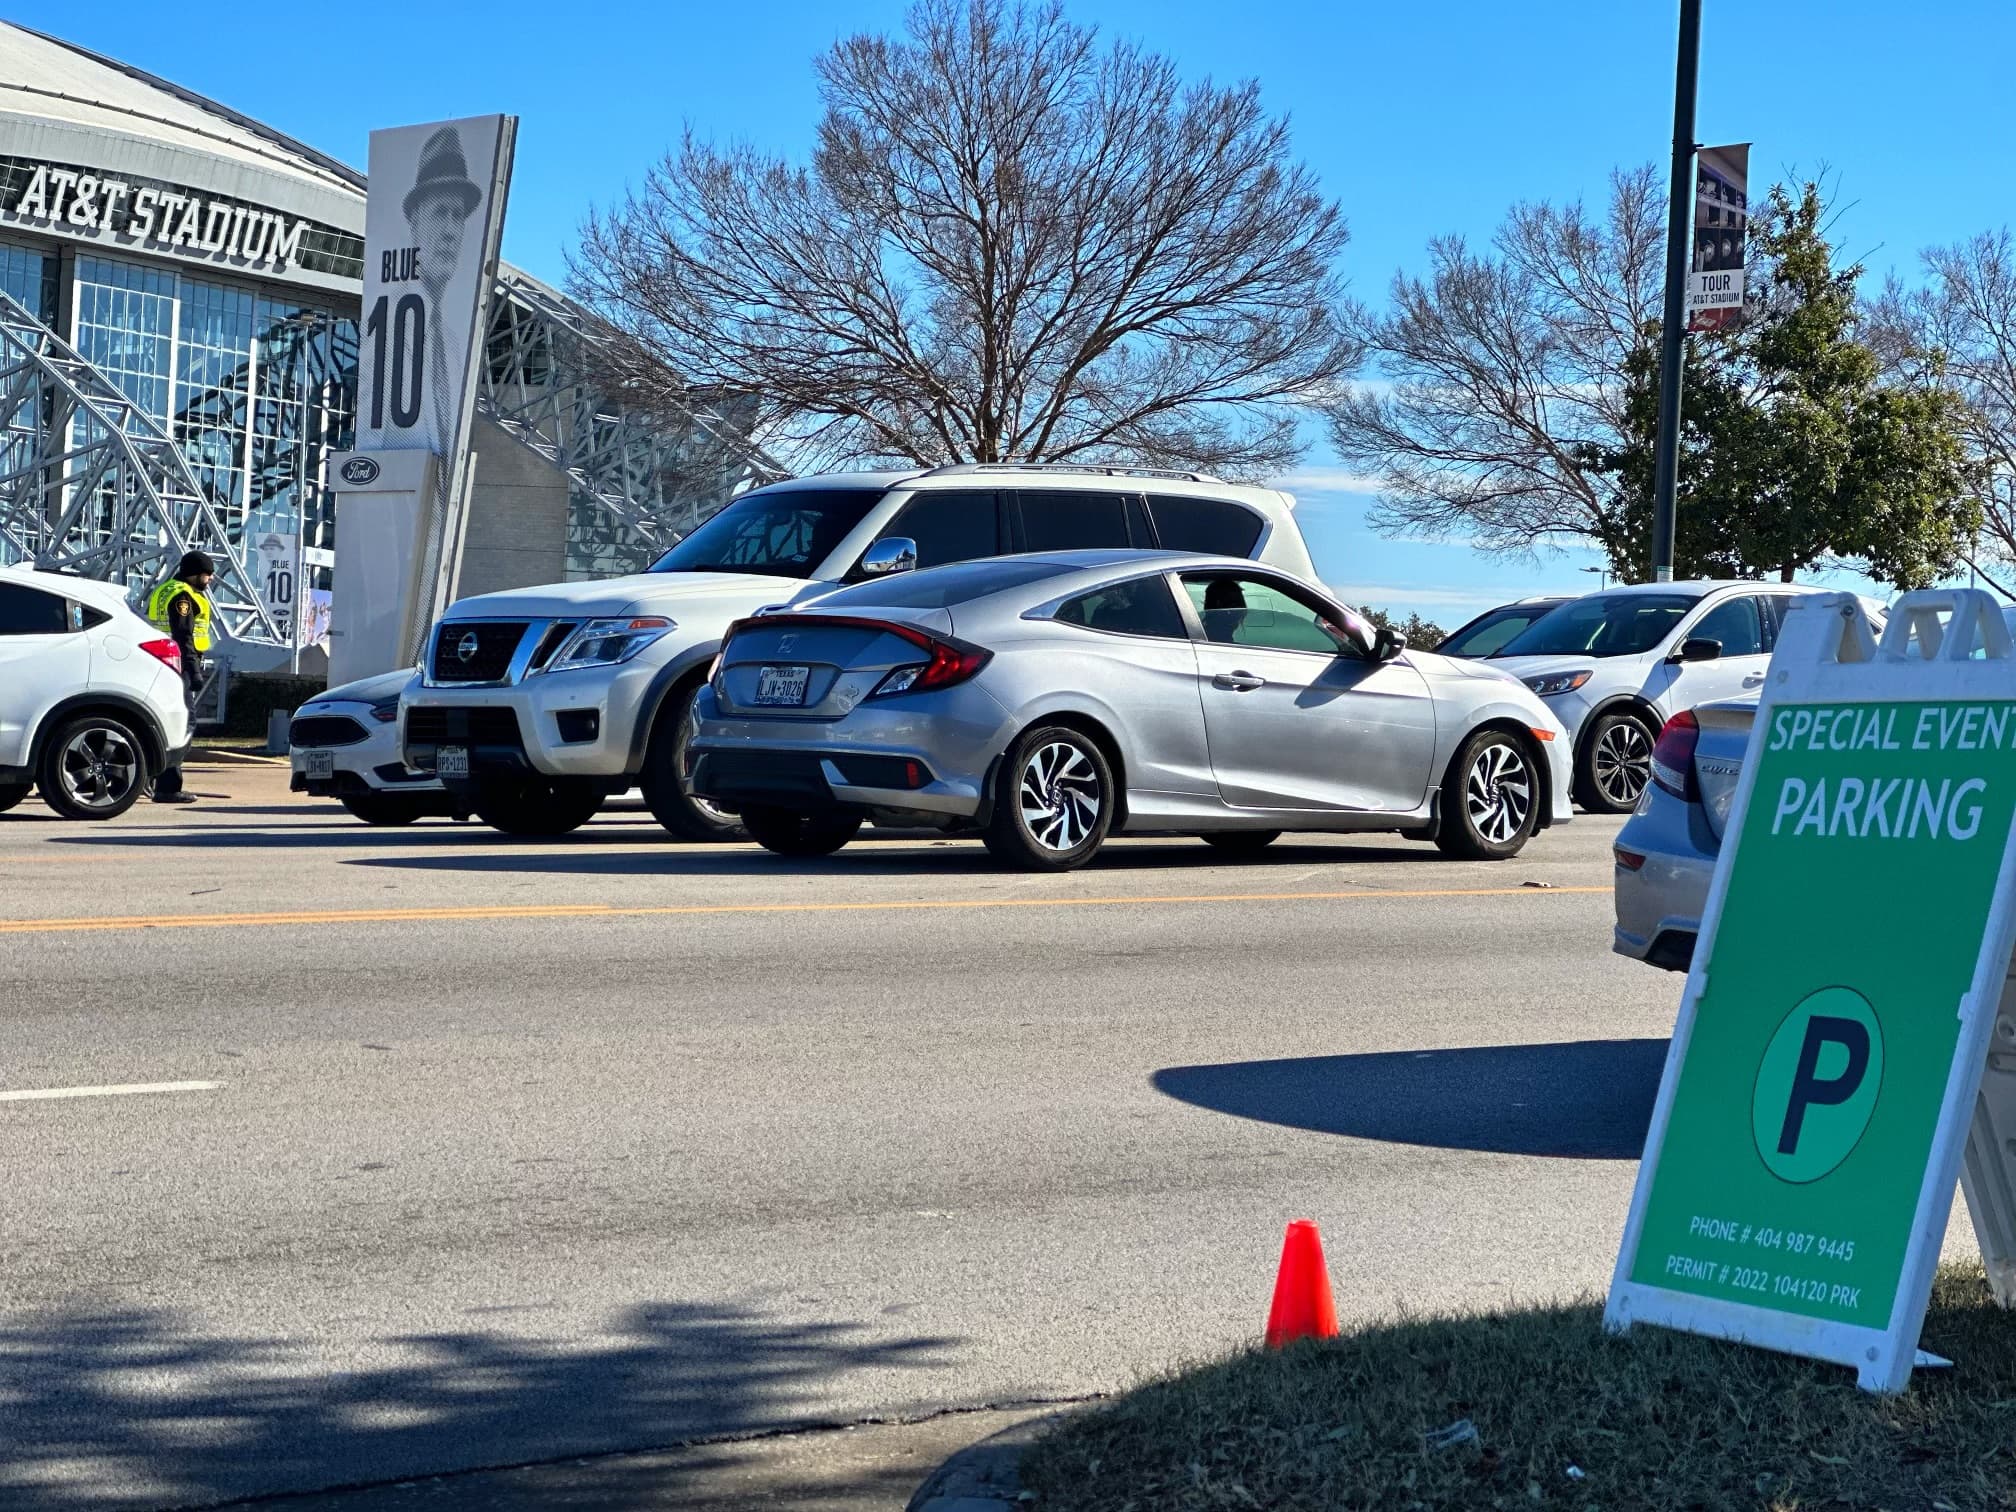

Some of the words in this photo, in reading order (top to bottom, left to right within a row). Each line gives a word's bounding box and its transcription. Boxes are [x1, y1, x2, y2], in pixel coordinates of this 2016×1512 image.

[16, 165, 127, 231] AT&T
[129, 187, 309, 266] STADIUM
[381, 247, 420, 283] BLUE
[1702, 275, 1730, 291] TOUR
[1693, 295, 1709, 304] AT&T
[1711, 293, 1740, 304] STADIUM
[367, 293, 425, 429] 10
[267, 571, 292, 603] 10
[272, 560, 289, 569] BLUE
[1769, 708, 1901, 751] SPECIAL
[1771, 777, 1988, 841] PARKING
[1777, 1015, 1871, 1155] P
[1689, 1215, 1739, 1242] PHONE
[1740, 1225, 1752, 1244] #
[1754, 1228, 1782, 1249] 404
[1786, 1231, 1815, 1254] 987
[1817, 1237, 1855, 1262] 9445
[1665, 1255, 1717, 1281] PERMIT
[1718, 1265, 1730, 1285] #
[1732, 1266, 1768, 1292] 2022
[1774, 1275, 1827, 1302] 104120
[1829, 1284, 1861, 1309] PRK
